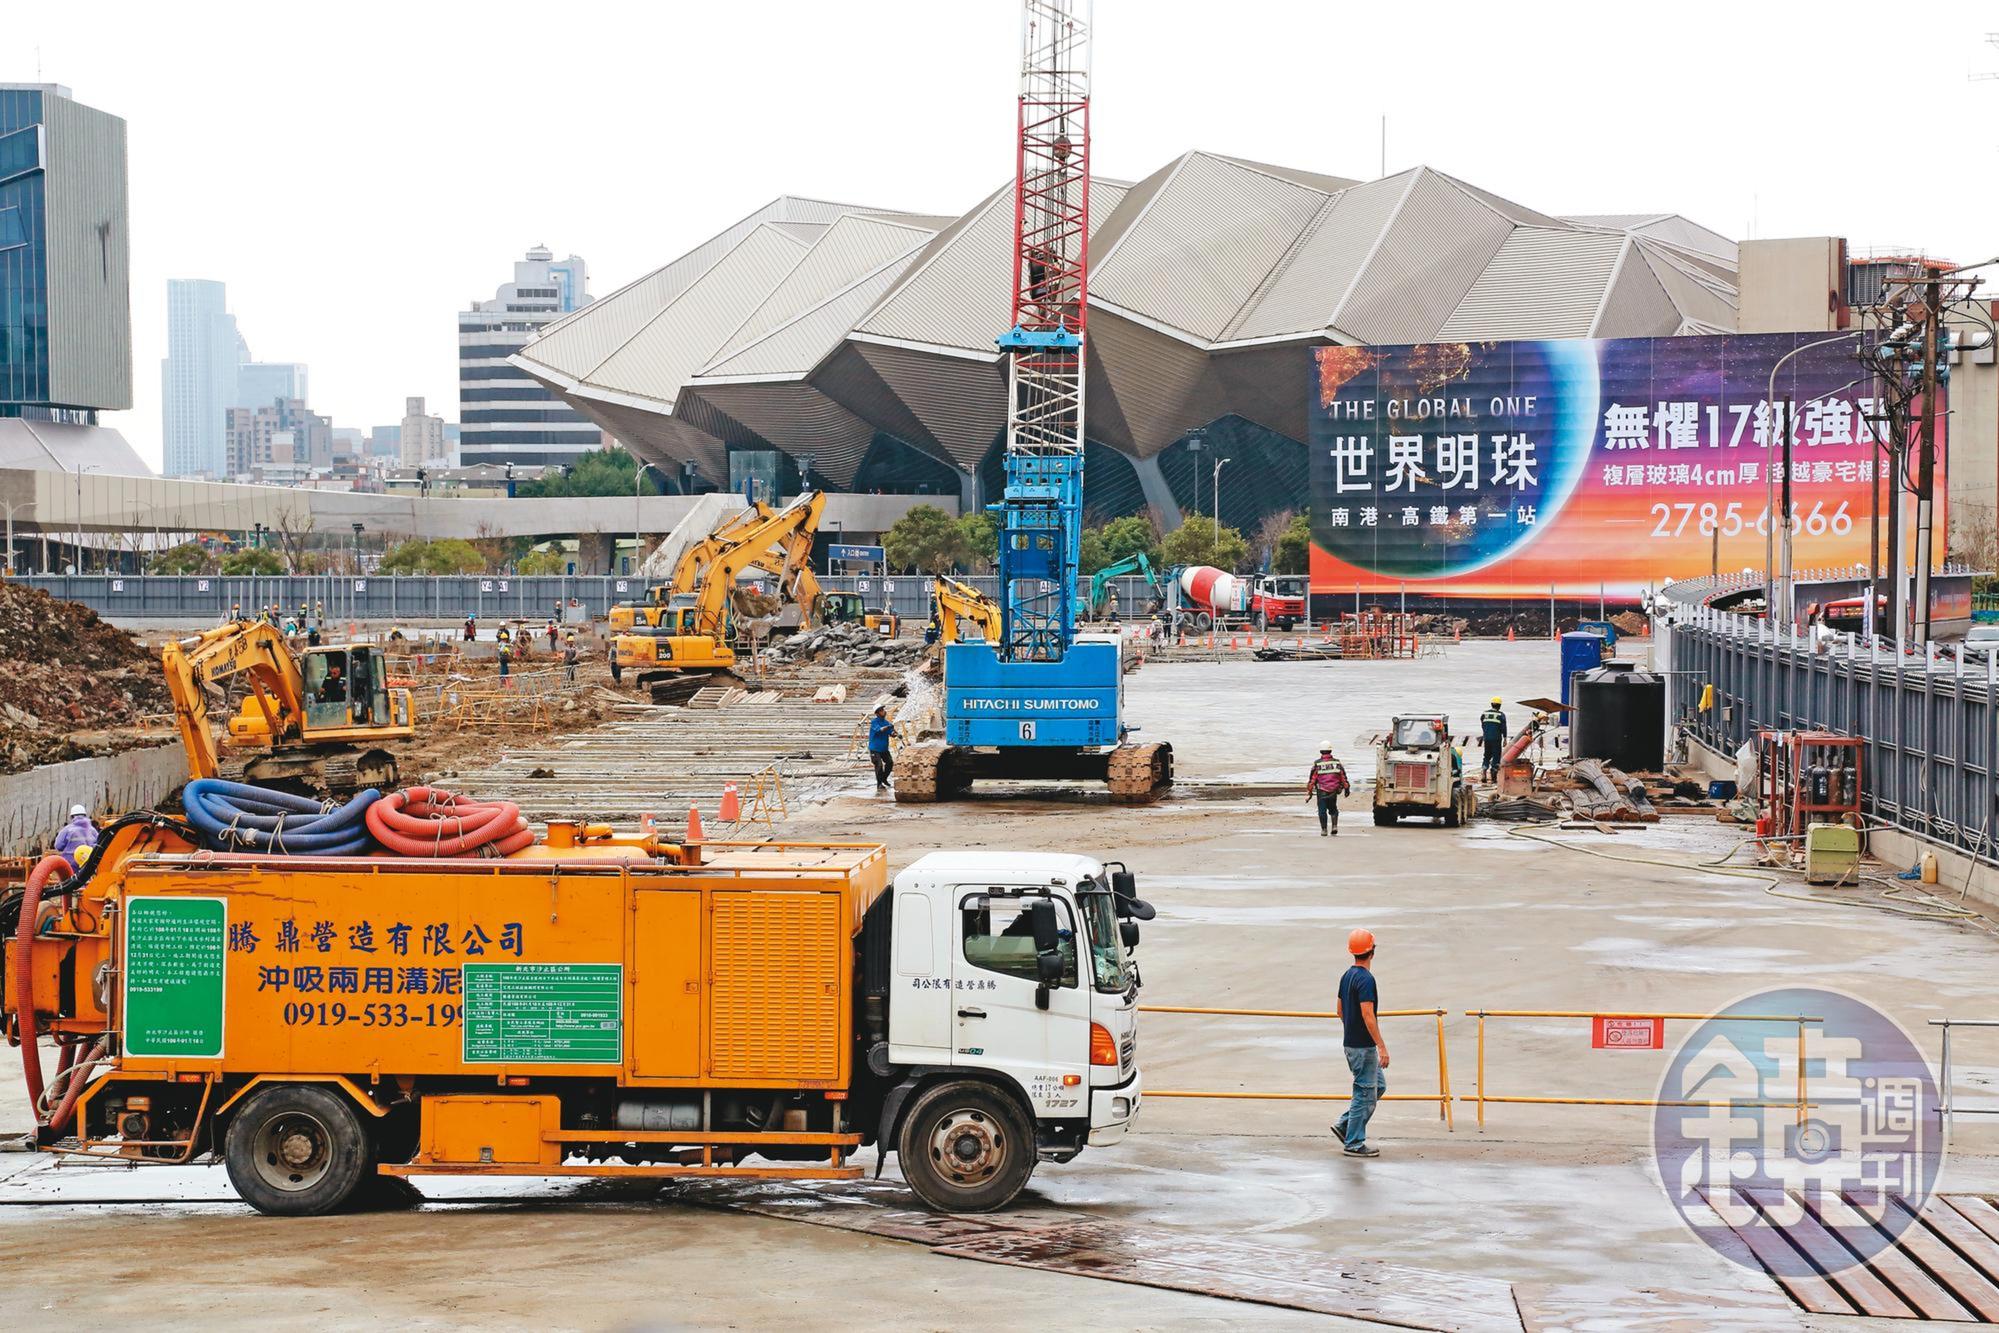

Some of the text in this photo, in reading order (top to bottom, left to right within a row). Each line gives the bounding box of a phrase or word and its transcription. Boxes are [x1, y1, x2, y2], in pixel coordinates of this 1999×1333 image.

[1330, 396, 1537, 420] THE GLOBAL ONE
[1330, 433, 1538, 494] 世界明珠
[1603, 462, 1759, 486] 複層玻璃4cm厚
[963, 699, 1099, 710] HITACHI SUMITOMO
[1021, 722, 1033, 740] 6
[228, 920, 524, 957] 騰鼎營造有限公司
[257, 965, 463, 994] 沖吸兩用溝泥
